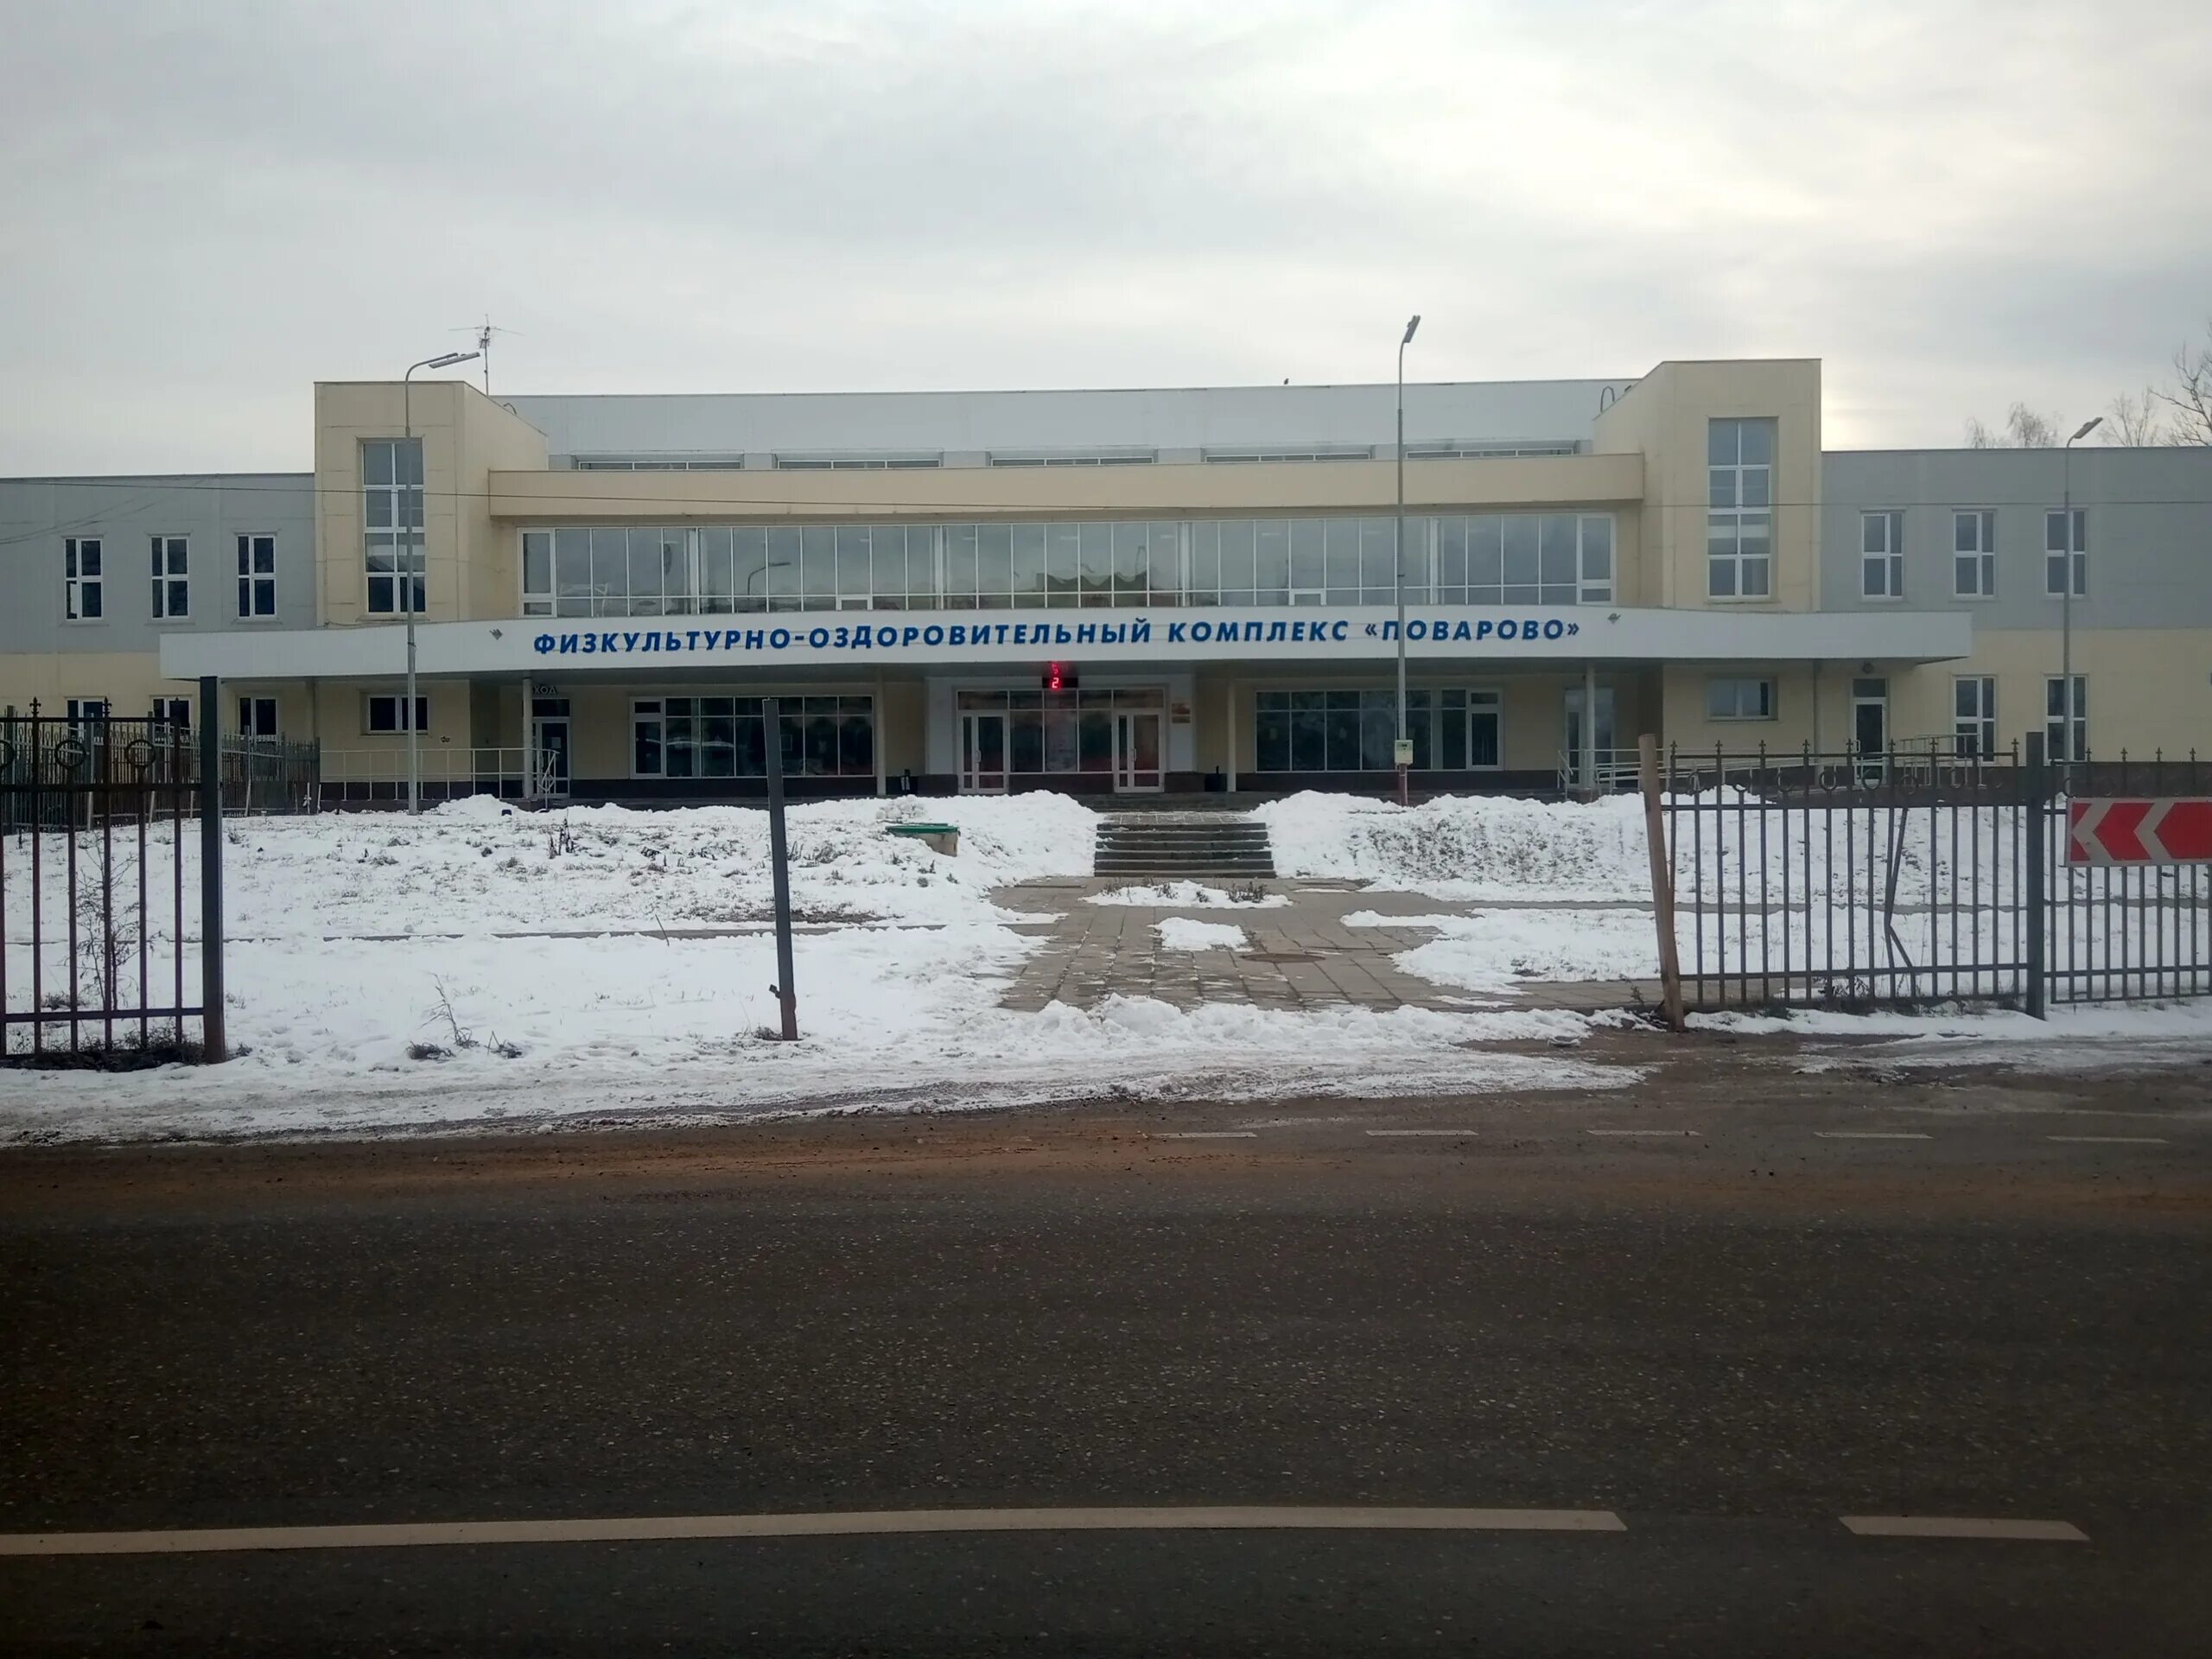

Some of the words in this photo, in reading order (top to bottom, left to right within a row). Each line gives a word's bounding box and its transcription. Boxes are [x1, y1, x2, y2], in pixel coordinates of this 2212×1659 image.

[533, 618, 1151, 654] ФИЗКУЛЬТУРНО-ОЗДОРОВИТЕЛЬНЫЙ
[1168, 620, 1349, 643] КОМПЛЕКС
[1365, 620, 1580, 641] «ПОВАРОВО»
[531, 685, 558, 696] ХОД
